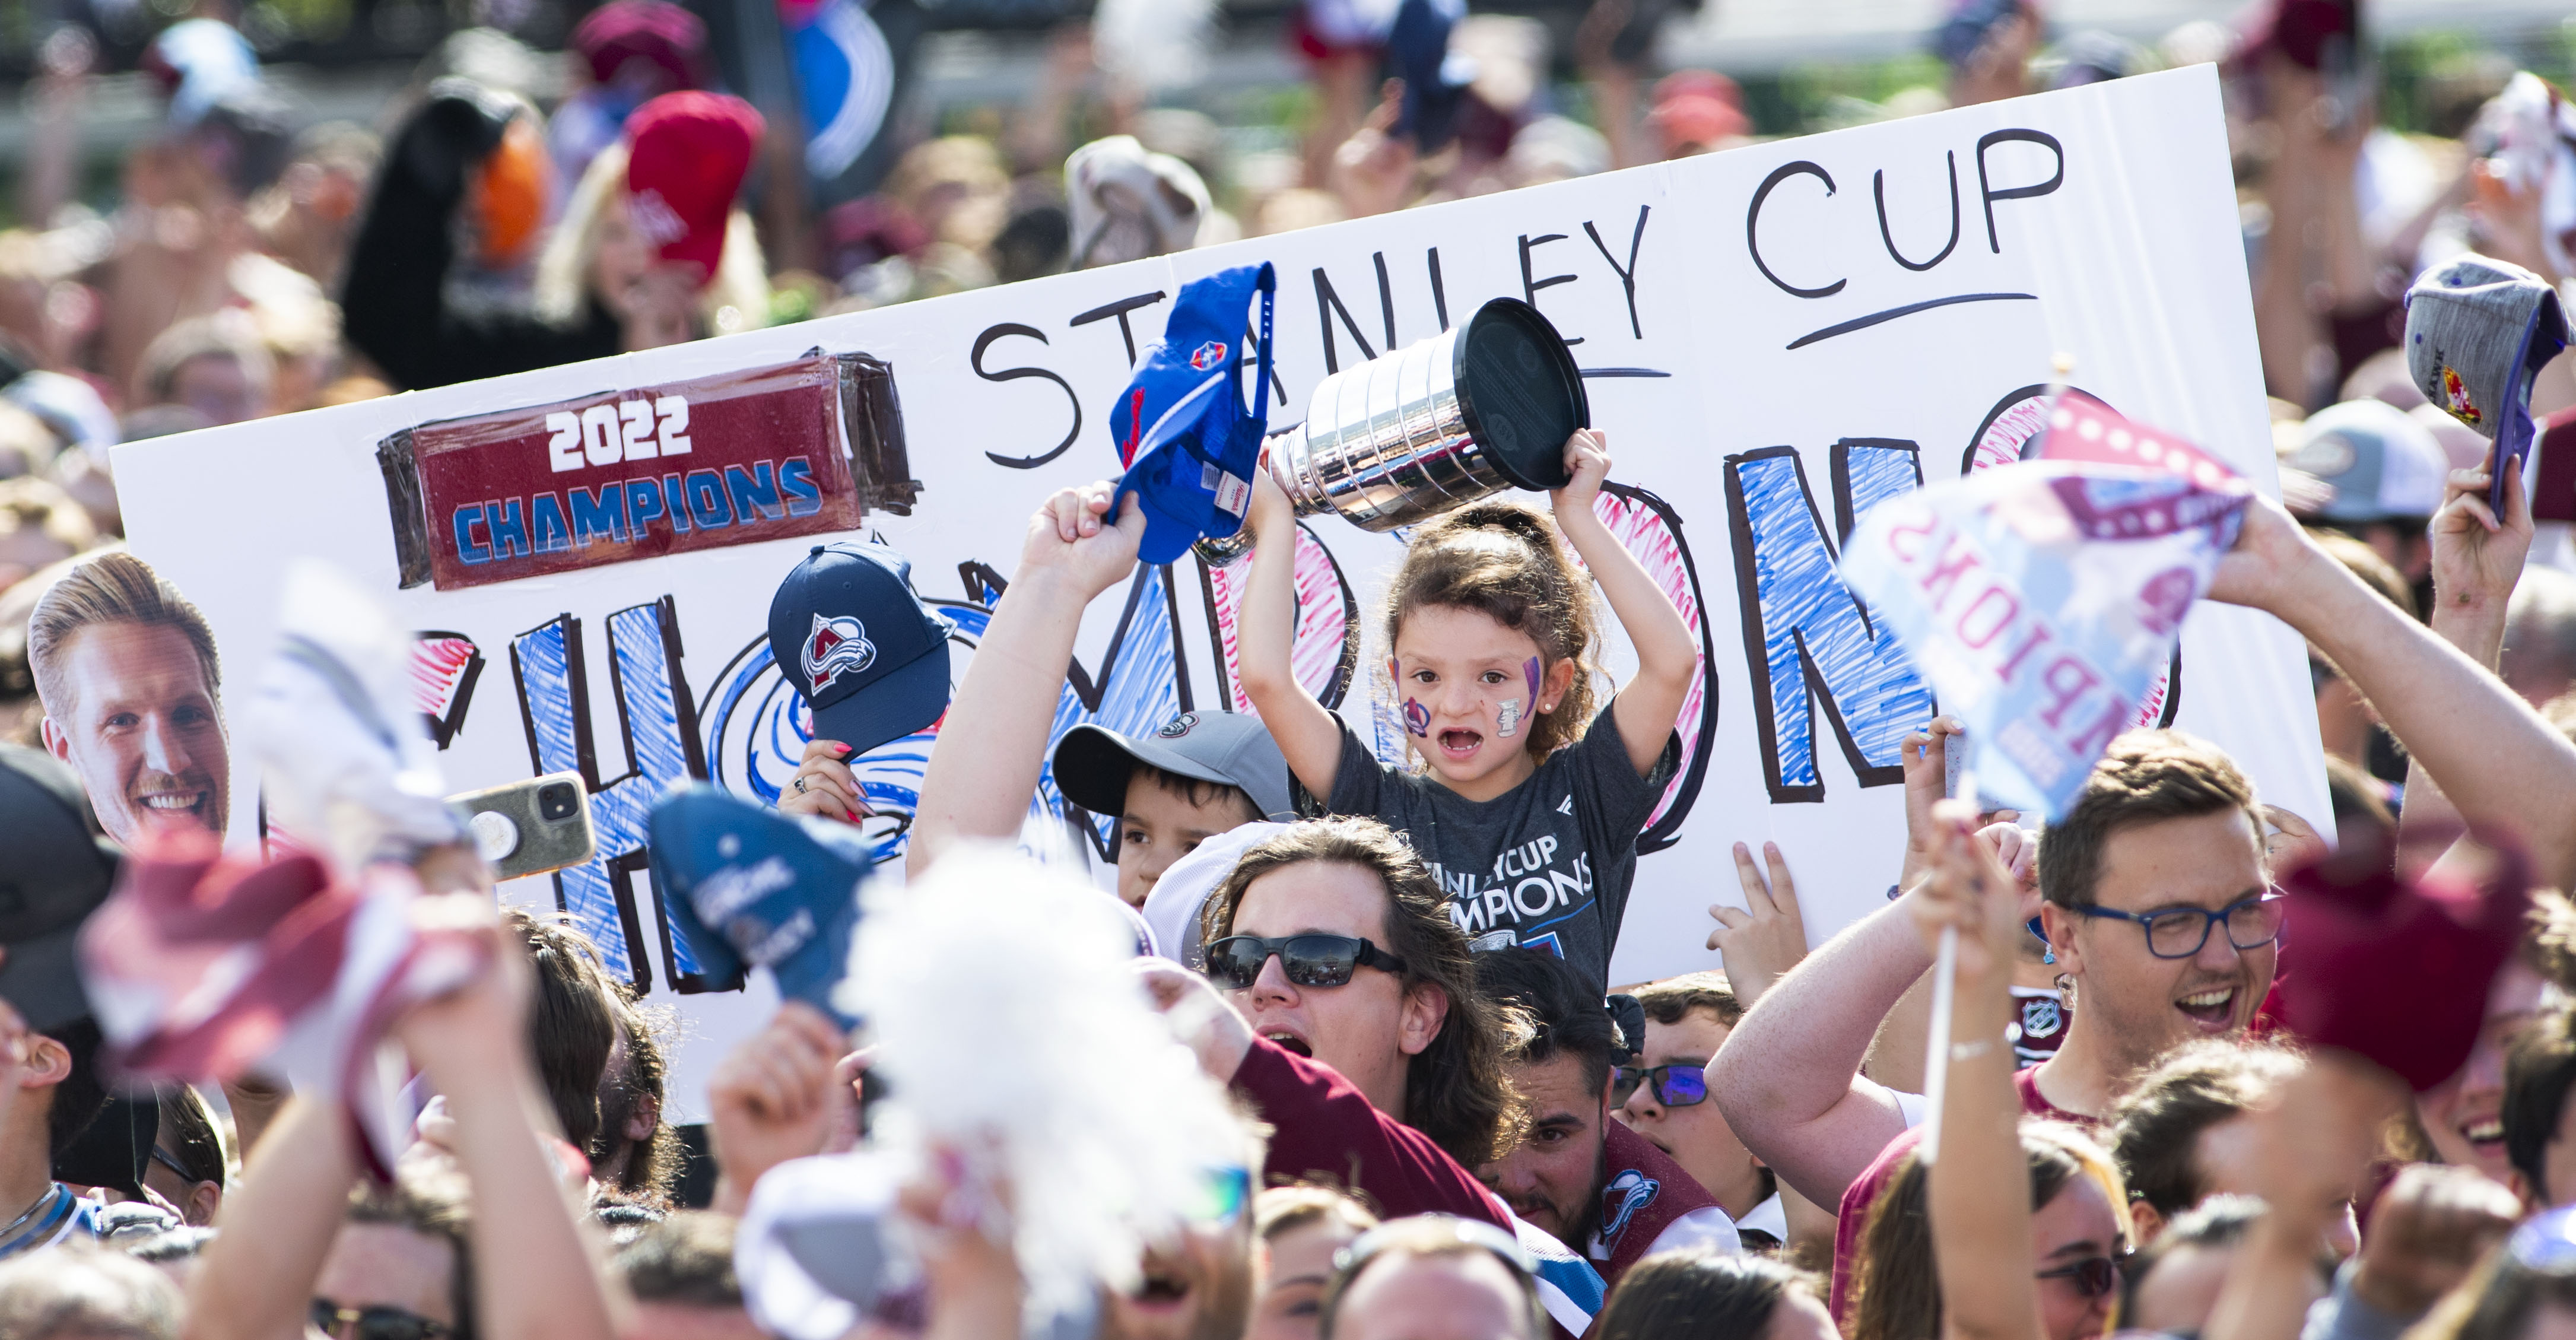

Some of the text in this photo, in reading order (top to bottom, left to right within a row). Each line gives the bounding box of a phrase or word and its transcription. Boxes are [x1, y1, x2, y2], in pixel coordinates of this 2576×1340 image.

[1746, 128, 2064, 298] CUP
[546, 395, 692, 474] 2022
[453, 456, 822, 564] CHAMPIONS
[1449, 851, 1593, 936] MPIONS
[1505, 835, 1558, 877] CUP
